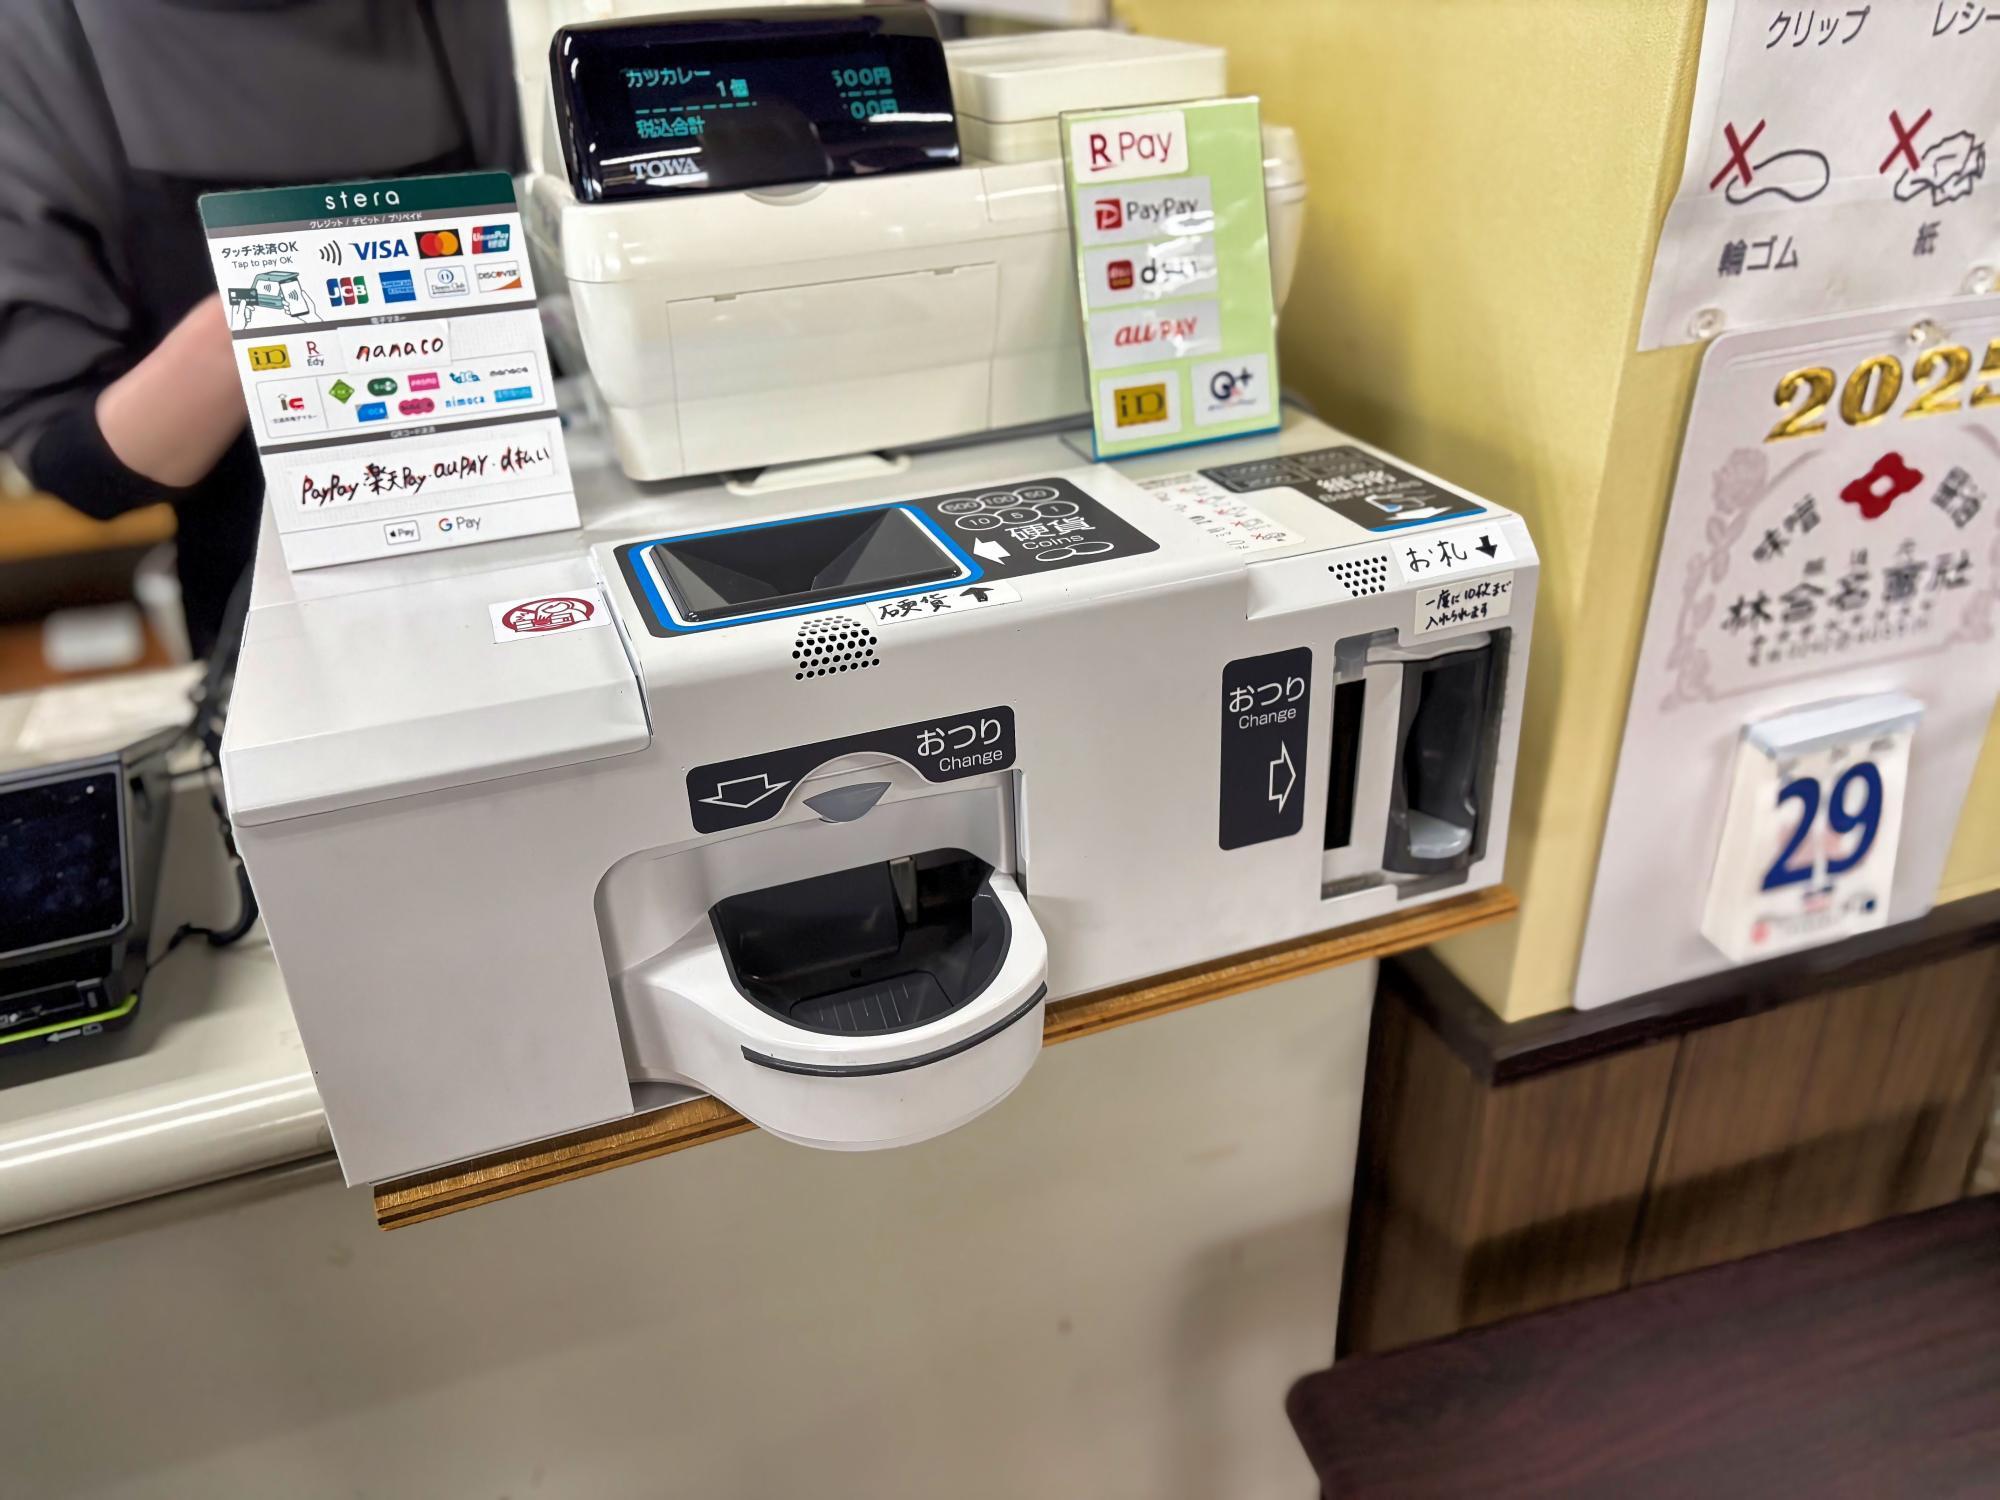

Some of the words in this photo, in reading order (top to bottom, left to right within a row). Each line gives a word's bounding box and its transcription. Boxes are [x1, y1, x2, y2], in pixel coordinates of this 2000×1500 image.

[1766, 5, 1871, 49] クリップ
[625, 66, 712, 88] カツカレー
[715, 78, 750, 98] 1個
[636, 116, 707, 139] 税込合計
[1118, 131, 1173, 163] Pay
[629, 158, 701, 180] TOWA
[324, 190, 401, 210] stera
[1126, 198, 1199, 223] PayPay
[221, 240, 299, 259] タッチ決済OK
[349, 239, 410, 261] VISA
[231, 260, 249, 270] Tap
[250, 259, 260, 268] to
[262, 257, 278, 268] pay
[279, 256, 294, 266] OK
[327, 281, 370, 302] JCB
[1159, 317, 1198, 340] PAY
[253, 350, 288, 366] iD
[355, 336, 445, 362] nanaco
[306, 356, 325, 368] Edy
[445, 394, 486, 408] nimoca
[1120, 391, 1165, 418] iD
[301, 475, 359, 506] PayPay
[456, 515, 482, 531] Pay
[1004, 515, 1097, 542] 硬貨
[1021, 534, 1085, 550] Coins
[1405, 540, 1468, 573] お札
[878, 593, 952, 620] 硬貨
[1228, 675, 1306, 713] おつり
[1238, 707, 1297, 730] Change
[916, 718, 1002, 757] おつり
[939, 749, 1003, 772] Change
[1760, 761, 1884, 894] 29
